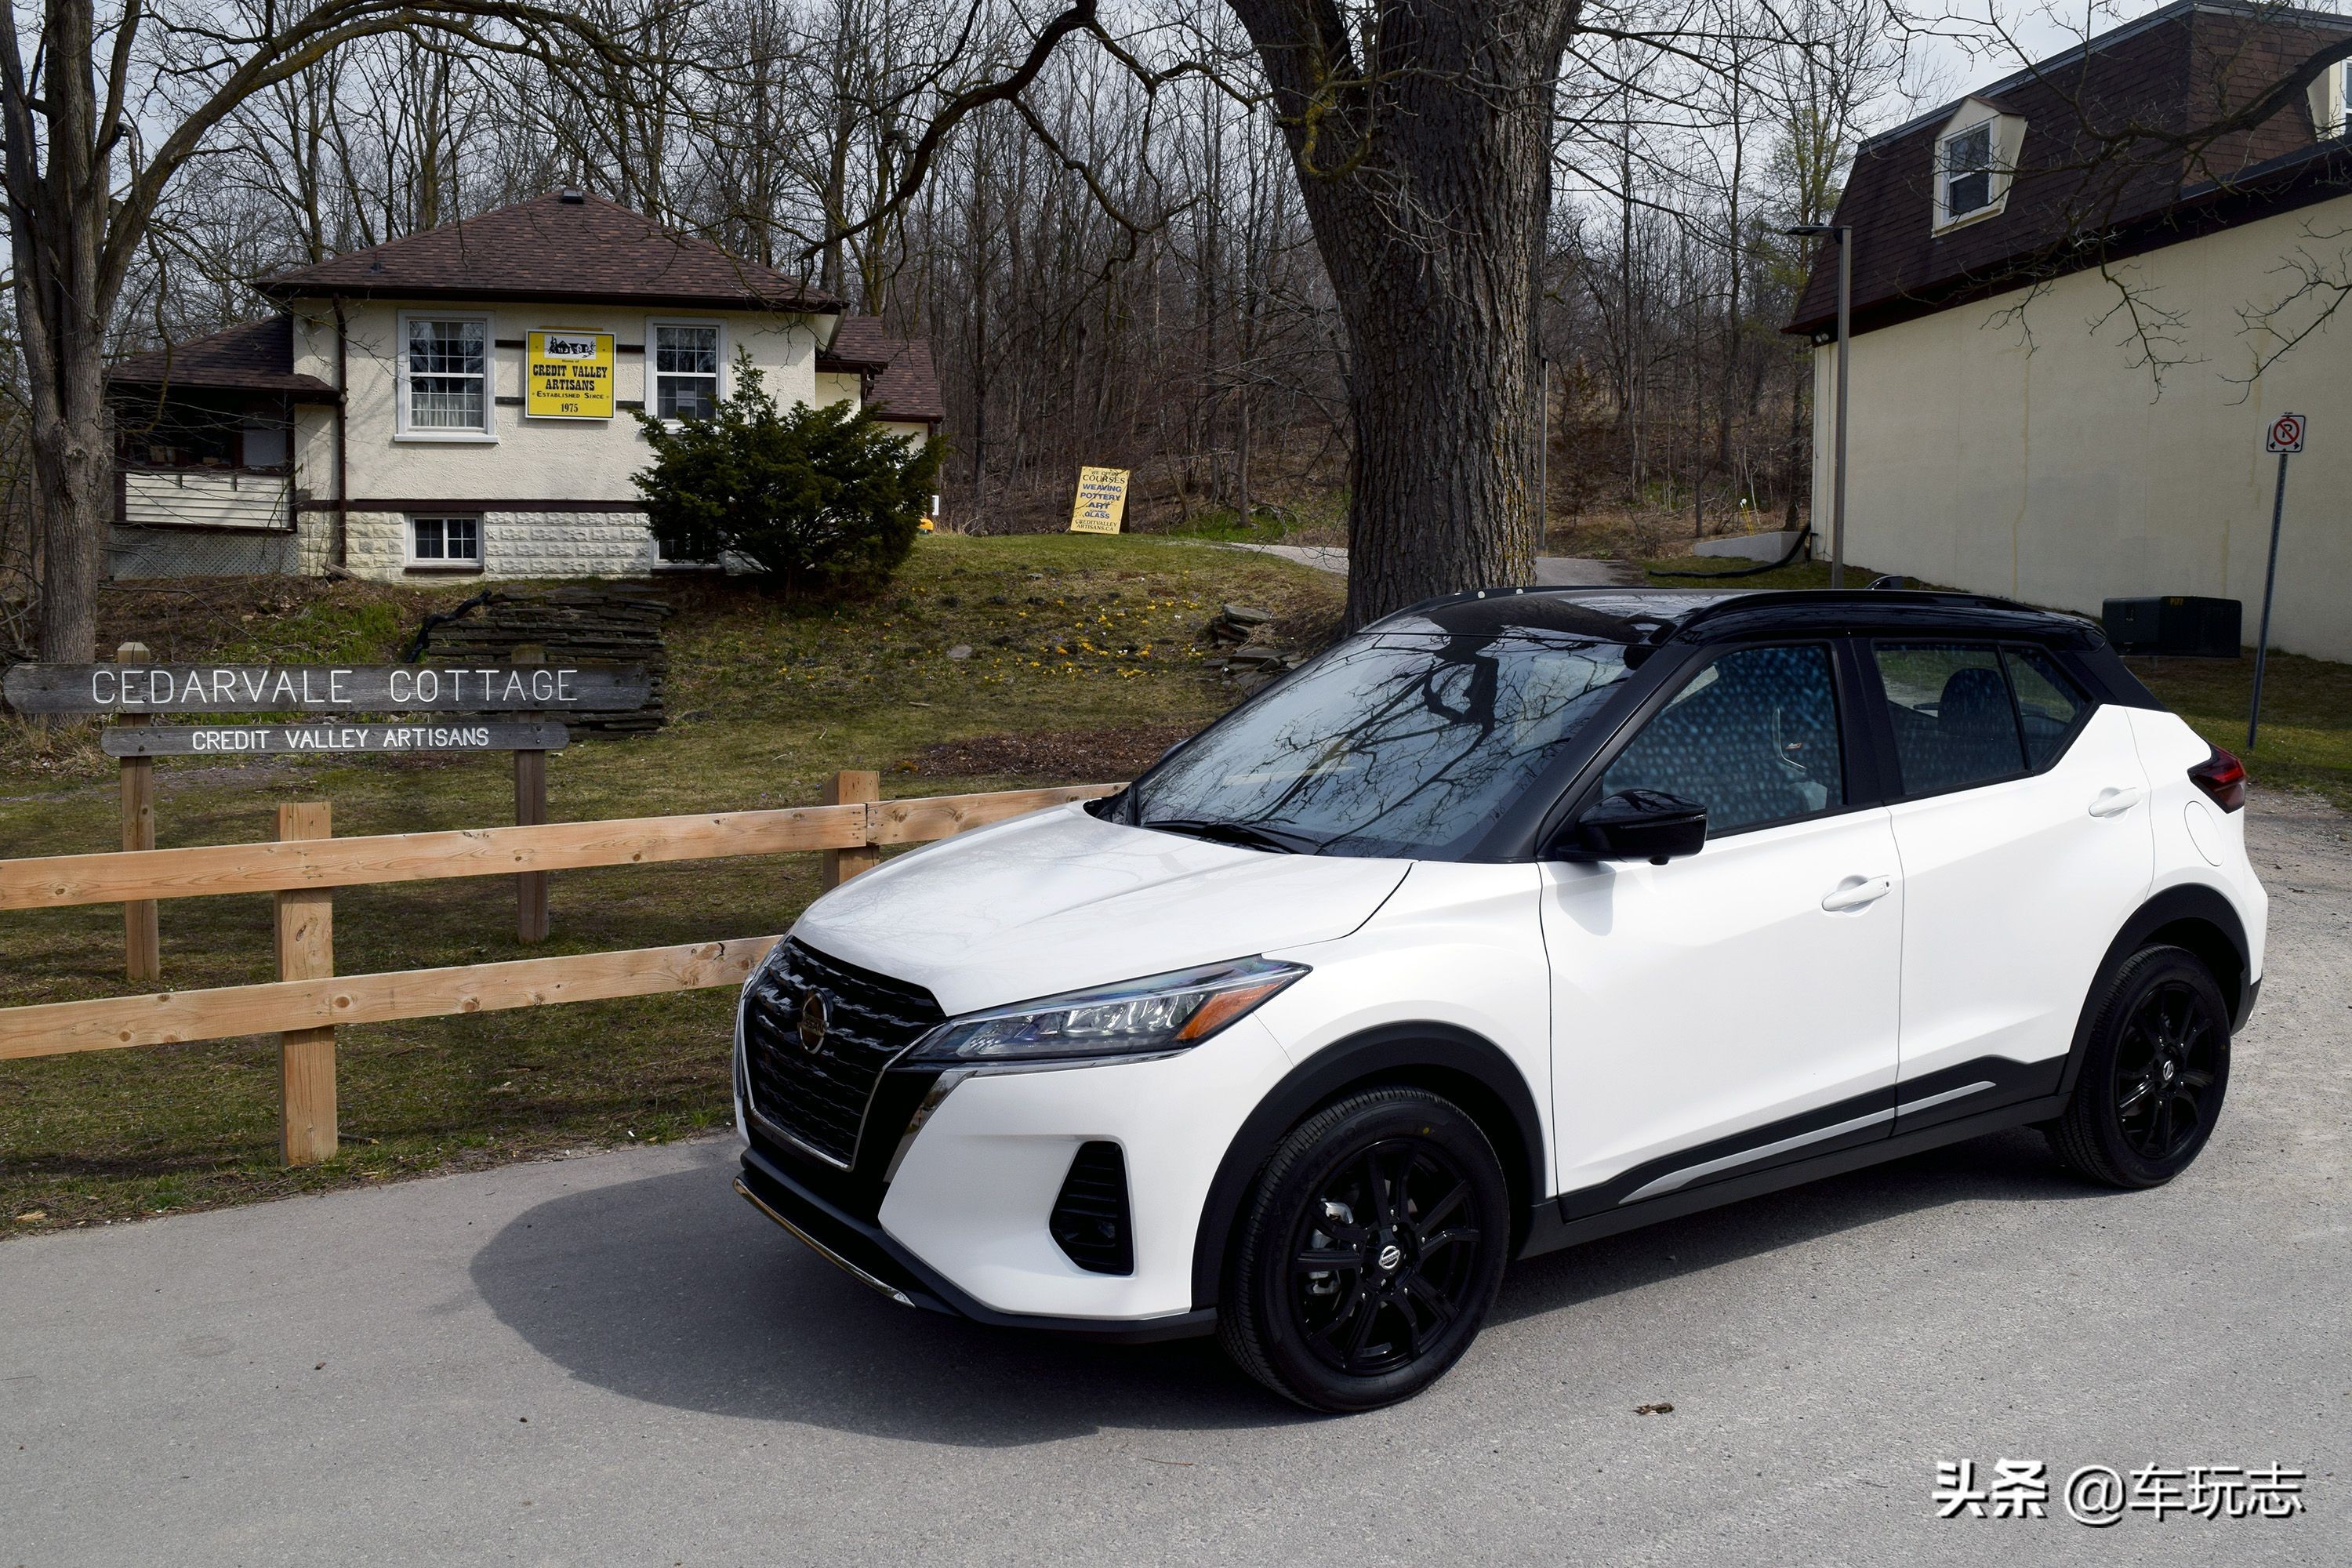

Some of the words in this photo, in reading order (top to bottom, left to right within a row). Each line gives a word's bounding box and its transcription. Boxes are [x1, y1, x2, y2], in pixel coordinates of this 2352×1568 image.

[533, 365, 567, 376] CREDIT
[572, 365, 608, 378] VALLEY
[546, 379, 595, 391] ARTISANS
[561, 403, 579, 412] 1975
[1083, 474, 1125, 484] COURSES
[1083, 484, 1122, 492] WEAVING
[1080, 492, 1121, 501] POTTERY
[93, 670, 352, 704] CEDARVALE
[390, 669, 578, 702] COTTAGE
[192, 730, 270, 750] CREDIT
[285, 728, 369, 748] VALLEY
[383, 727, 489, 746] ARTISANS
